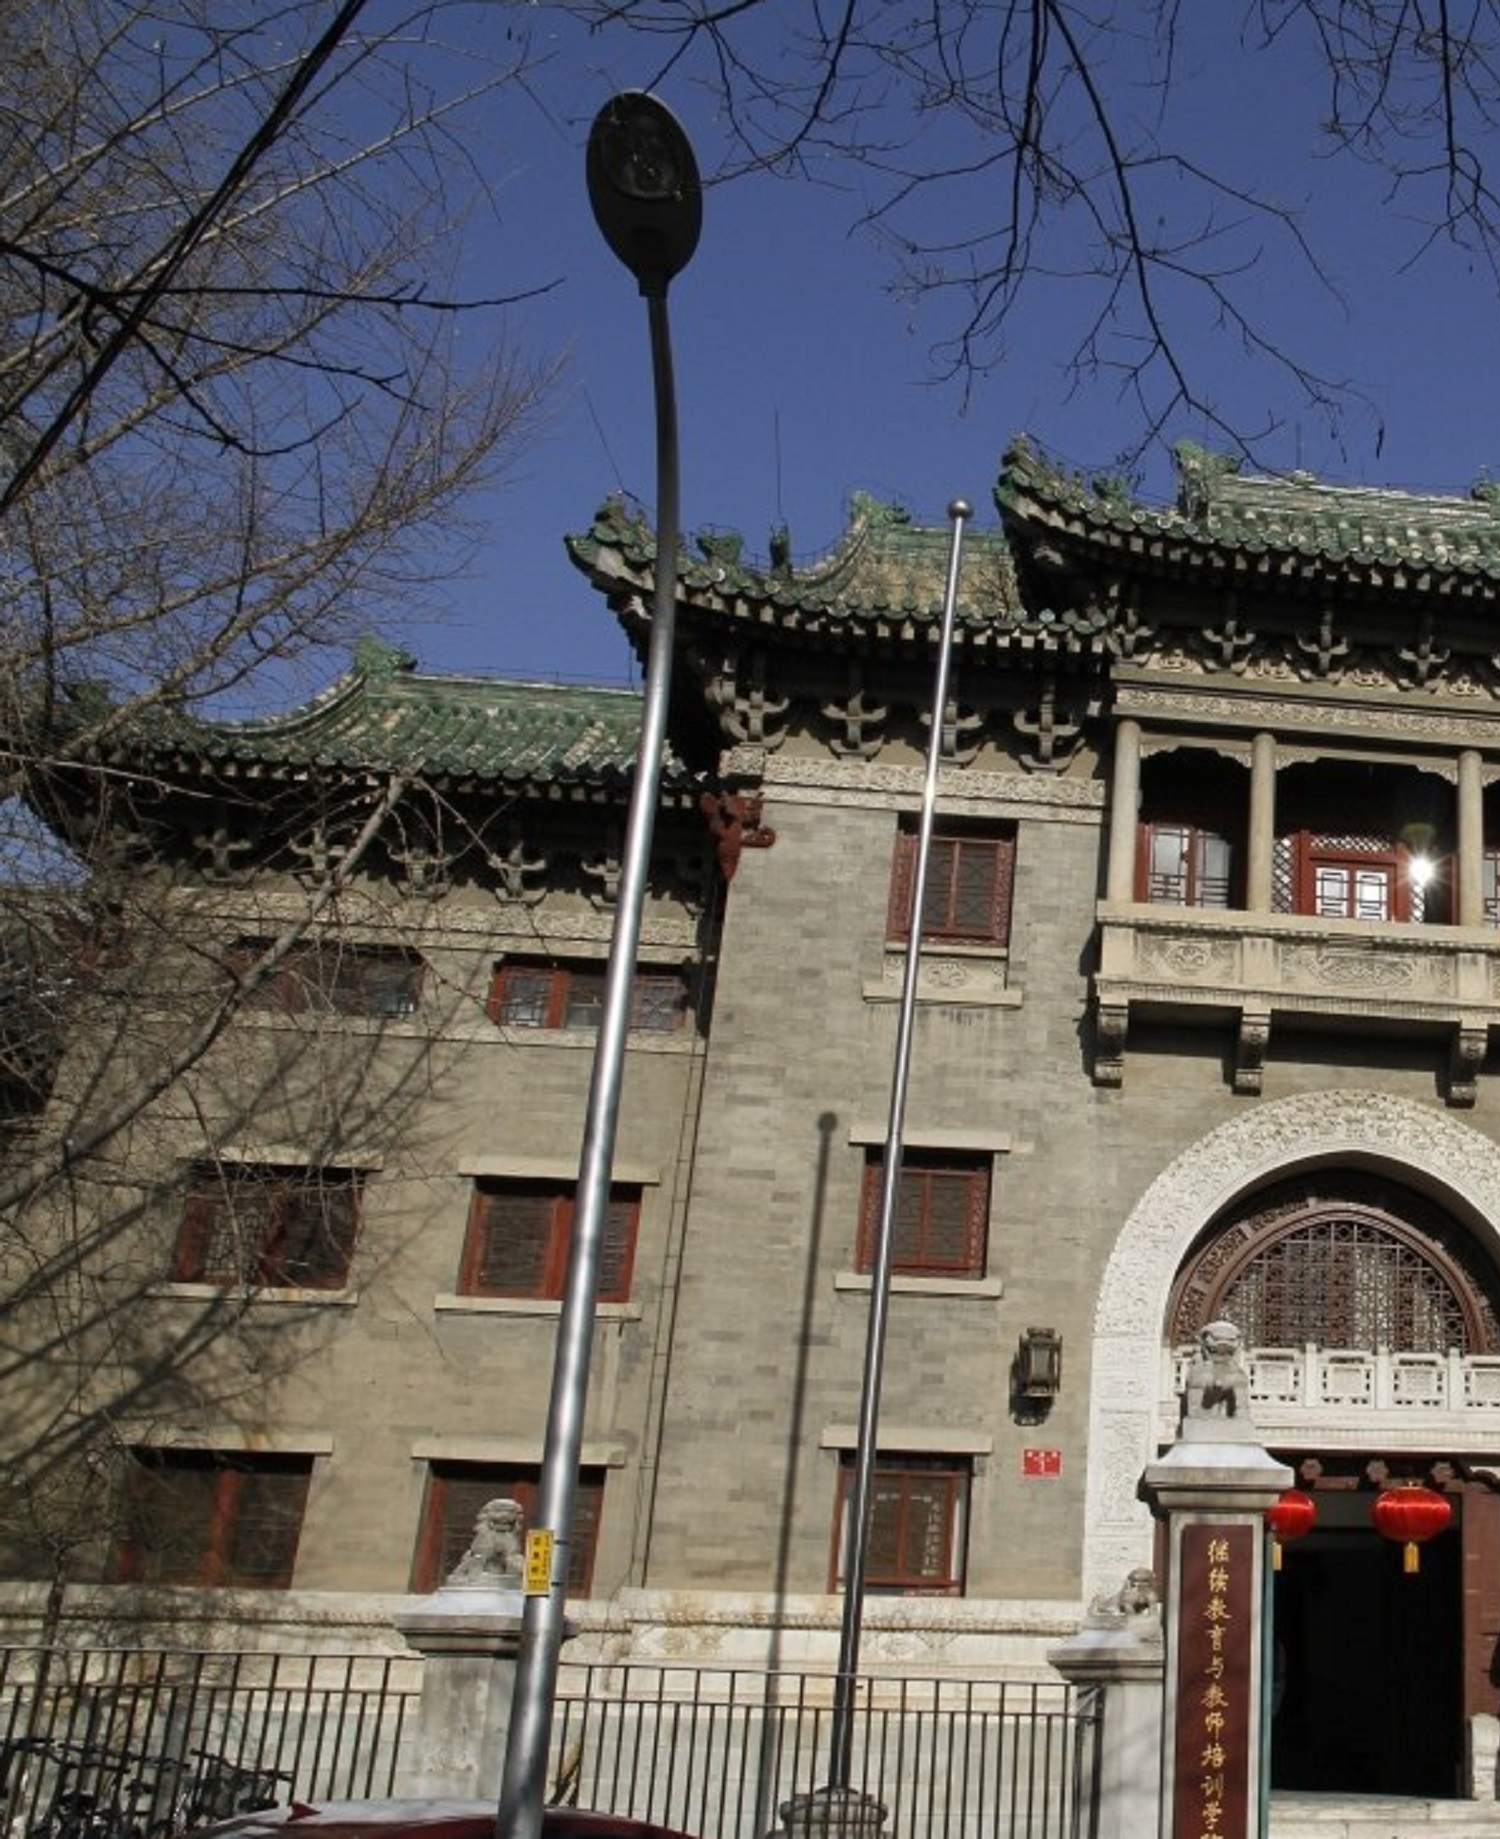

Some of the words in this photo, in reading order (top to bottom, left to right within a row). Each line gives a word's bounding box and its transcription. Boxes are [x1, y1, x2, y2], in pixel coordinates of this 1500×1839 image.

[1200, 1539, 1232, 1839] 继续教育与教师培训学
